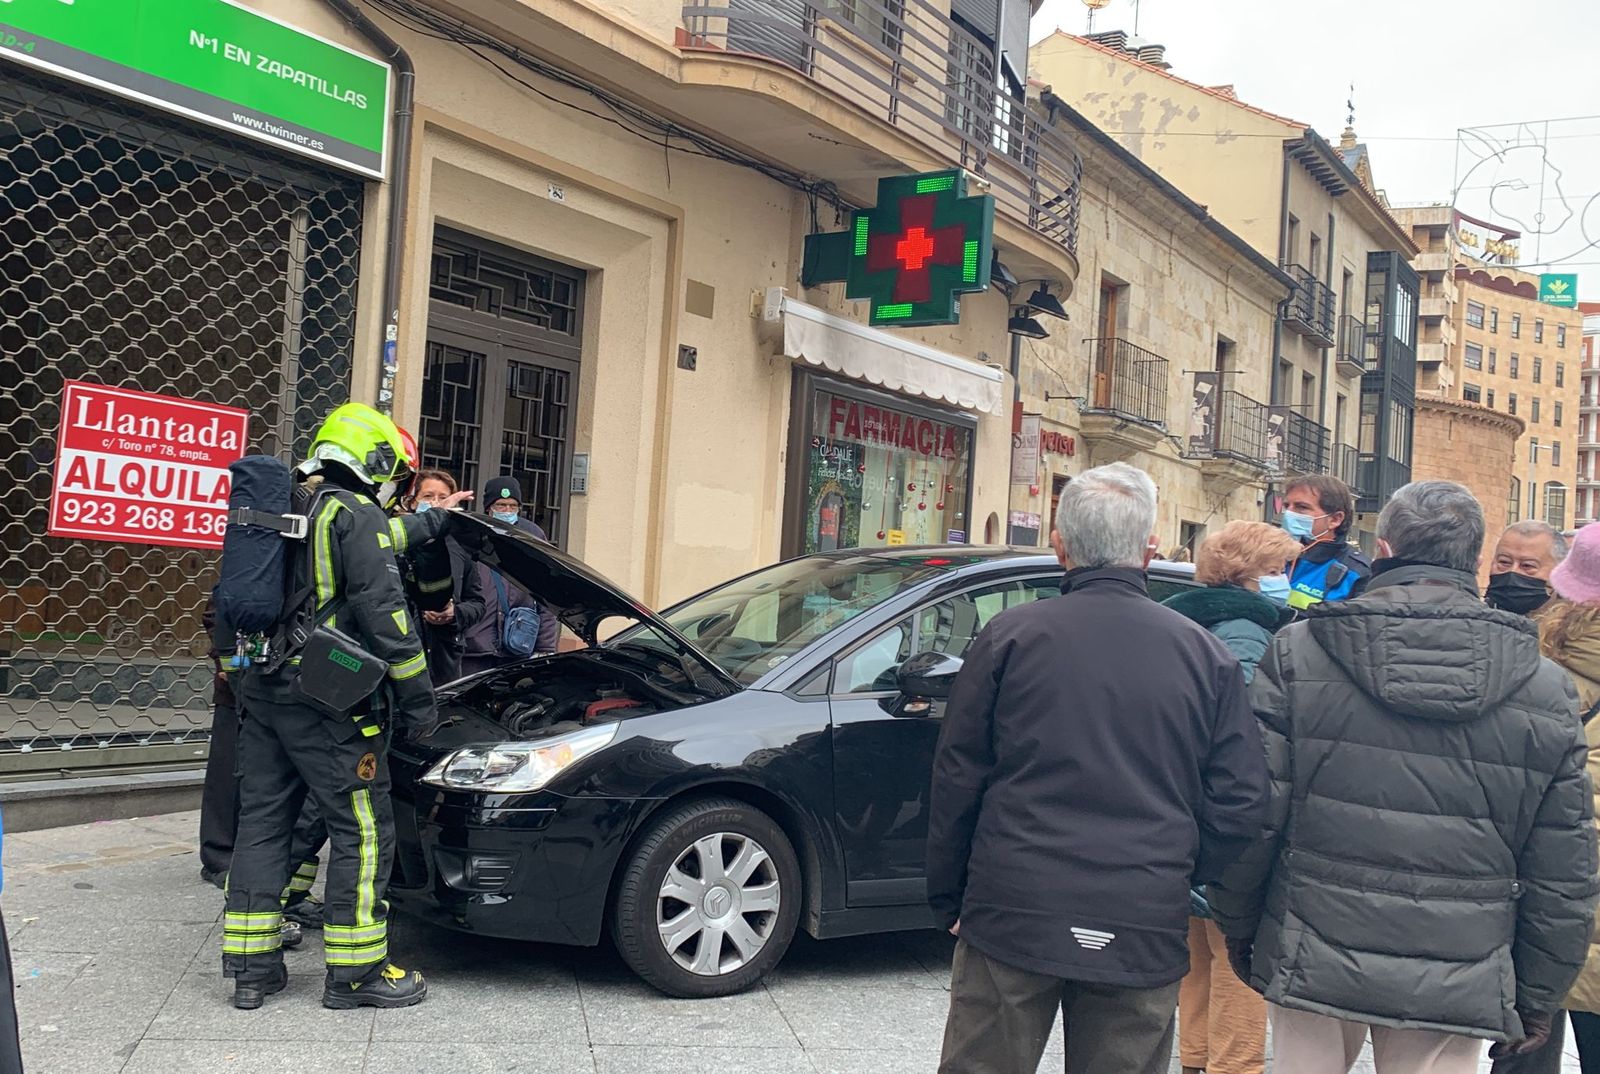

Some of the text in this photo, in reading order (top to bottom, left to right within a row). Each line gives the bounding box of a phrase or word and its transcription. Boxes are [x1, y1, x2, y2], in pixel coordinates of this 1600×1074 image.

[224, 44, 251, 66] EN
[256, 55, 368, 110] ZAPATILLAS
[232, 111, 325, 151] www.twinner.es
[72, 395, 238, 450] Llantada
[829, 395, 957, 460] FARMACIA
[102, 437, 115, 450] c/
[118, 438, 142, 452] Toro
[62, 455, 232, 506] ALQUILA
[62, 499, 229, 536] 923 268 136
[331, 652, 359, 670] MSA
[682, 812, 743, 838] MICHELIN
